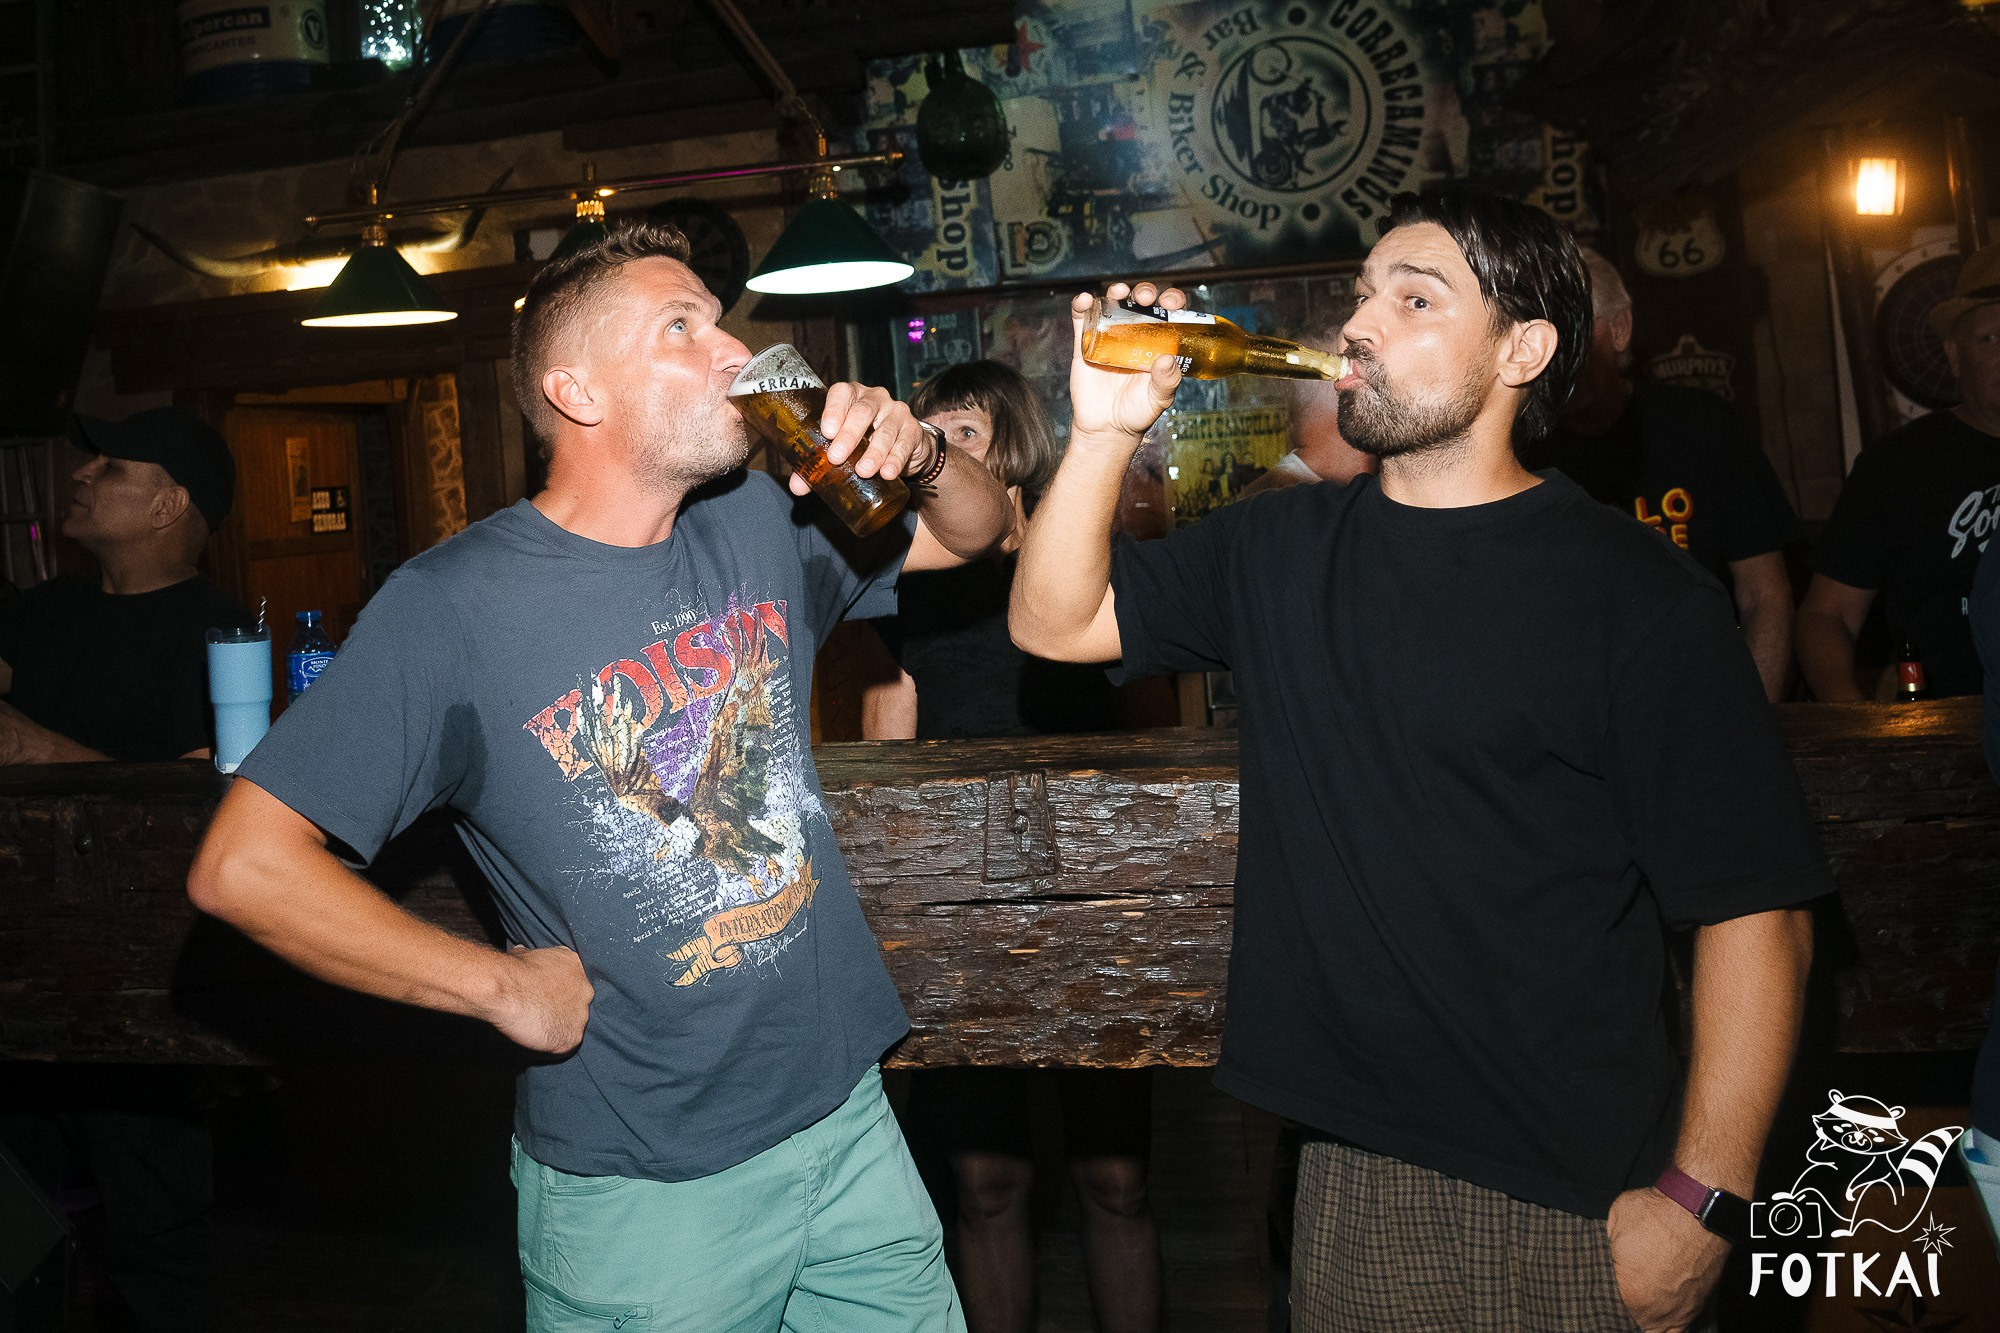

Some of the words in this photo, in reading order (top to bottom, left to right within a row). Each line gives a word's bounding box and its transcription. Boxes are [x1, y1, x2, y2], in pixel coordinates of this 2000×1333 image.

[1203, 9, 1260, 50] Bar
[1173, 51, 1207, 80] &
[1330, 0, 1423, 219] CORRECAMINOS
[1168, 92, 1203, 175] Biker
[1201, 174, 1281, 229] Shop
[1658, 237, 1704, 268] 66
[651, 618, 675, 636] Est.
[674, 609, 698, 630] 1990
